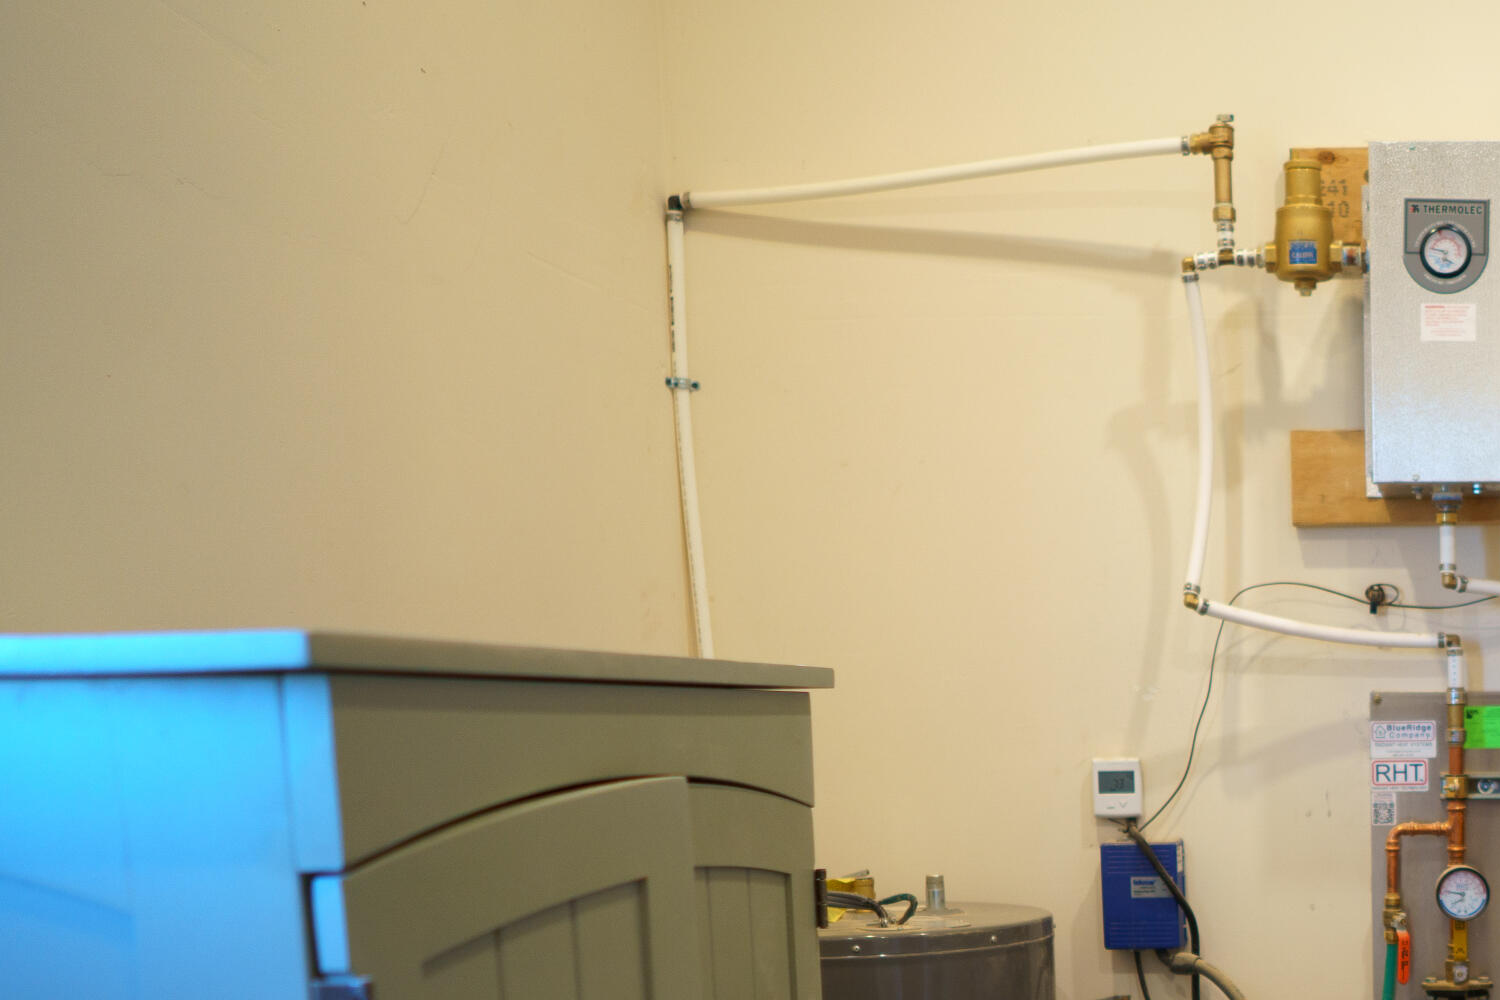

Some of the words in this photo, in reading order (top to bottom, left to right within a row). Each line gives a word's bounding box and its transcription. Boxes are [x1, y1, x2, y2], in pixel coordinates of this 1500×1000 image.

[1423, 204, 1482, 215] THERMOLEC
[1386, 724, 1432, 732] BlueRidge
[1375, 763, 1424, 782] RHT
